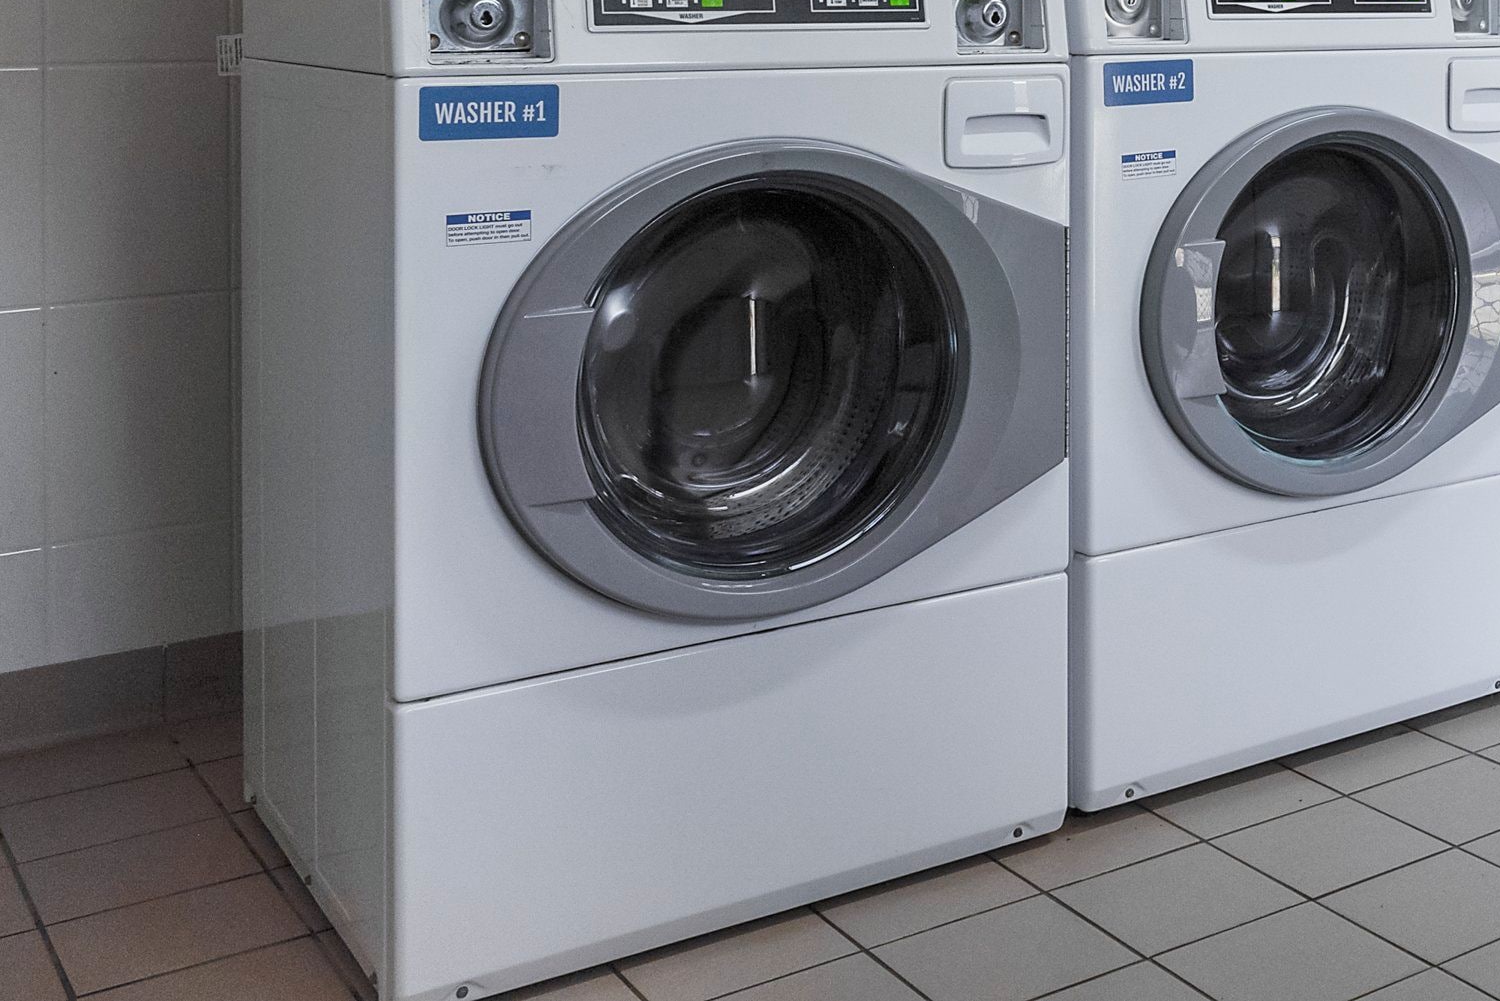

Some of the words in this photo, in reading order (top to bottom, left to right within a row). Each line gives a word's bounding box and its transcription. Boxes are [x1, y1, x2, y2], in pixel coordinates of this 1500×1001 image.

[1112, 73, 1165, 93] WASHER
[1169, 72, 1186, 89] #2
[435, 101, 516, 125] WASHER
[522, 101, 546, 122] #1
[1136, 152, 1163, 161] NOTICE
[468, 212, 511, 223] NOTICE
